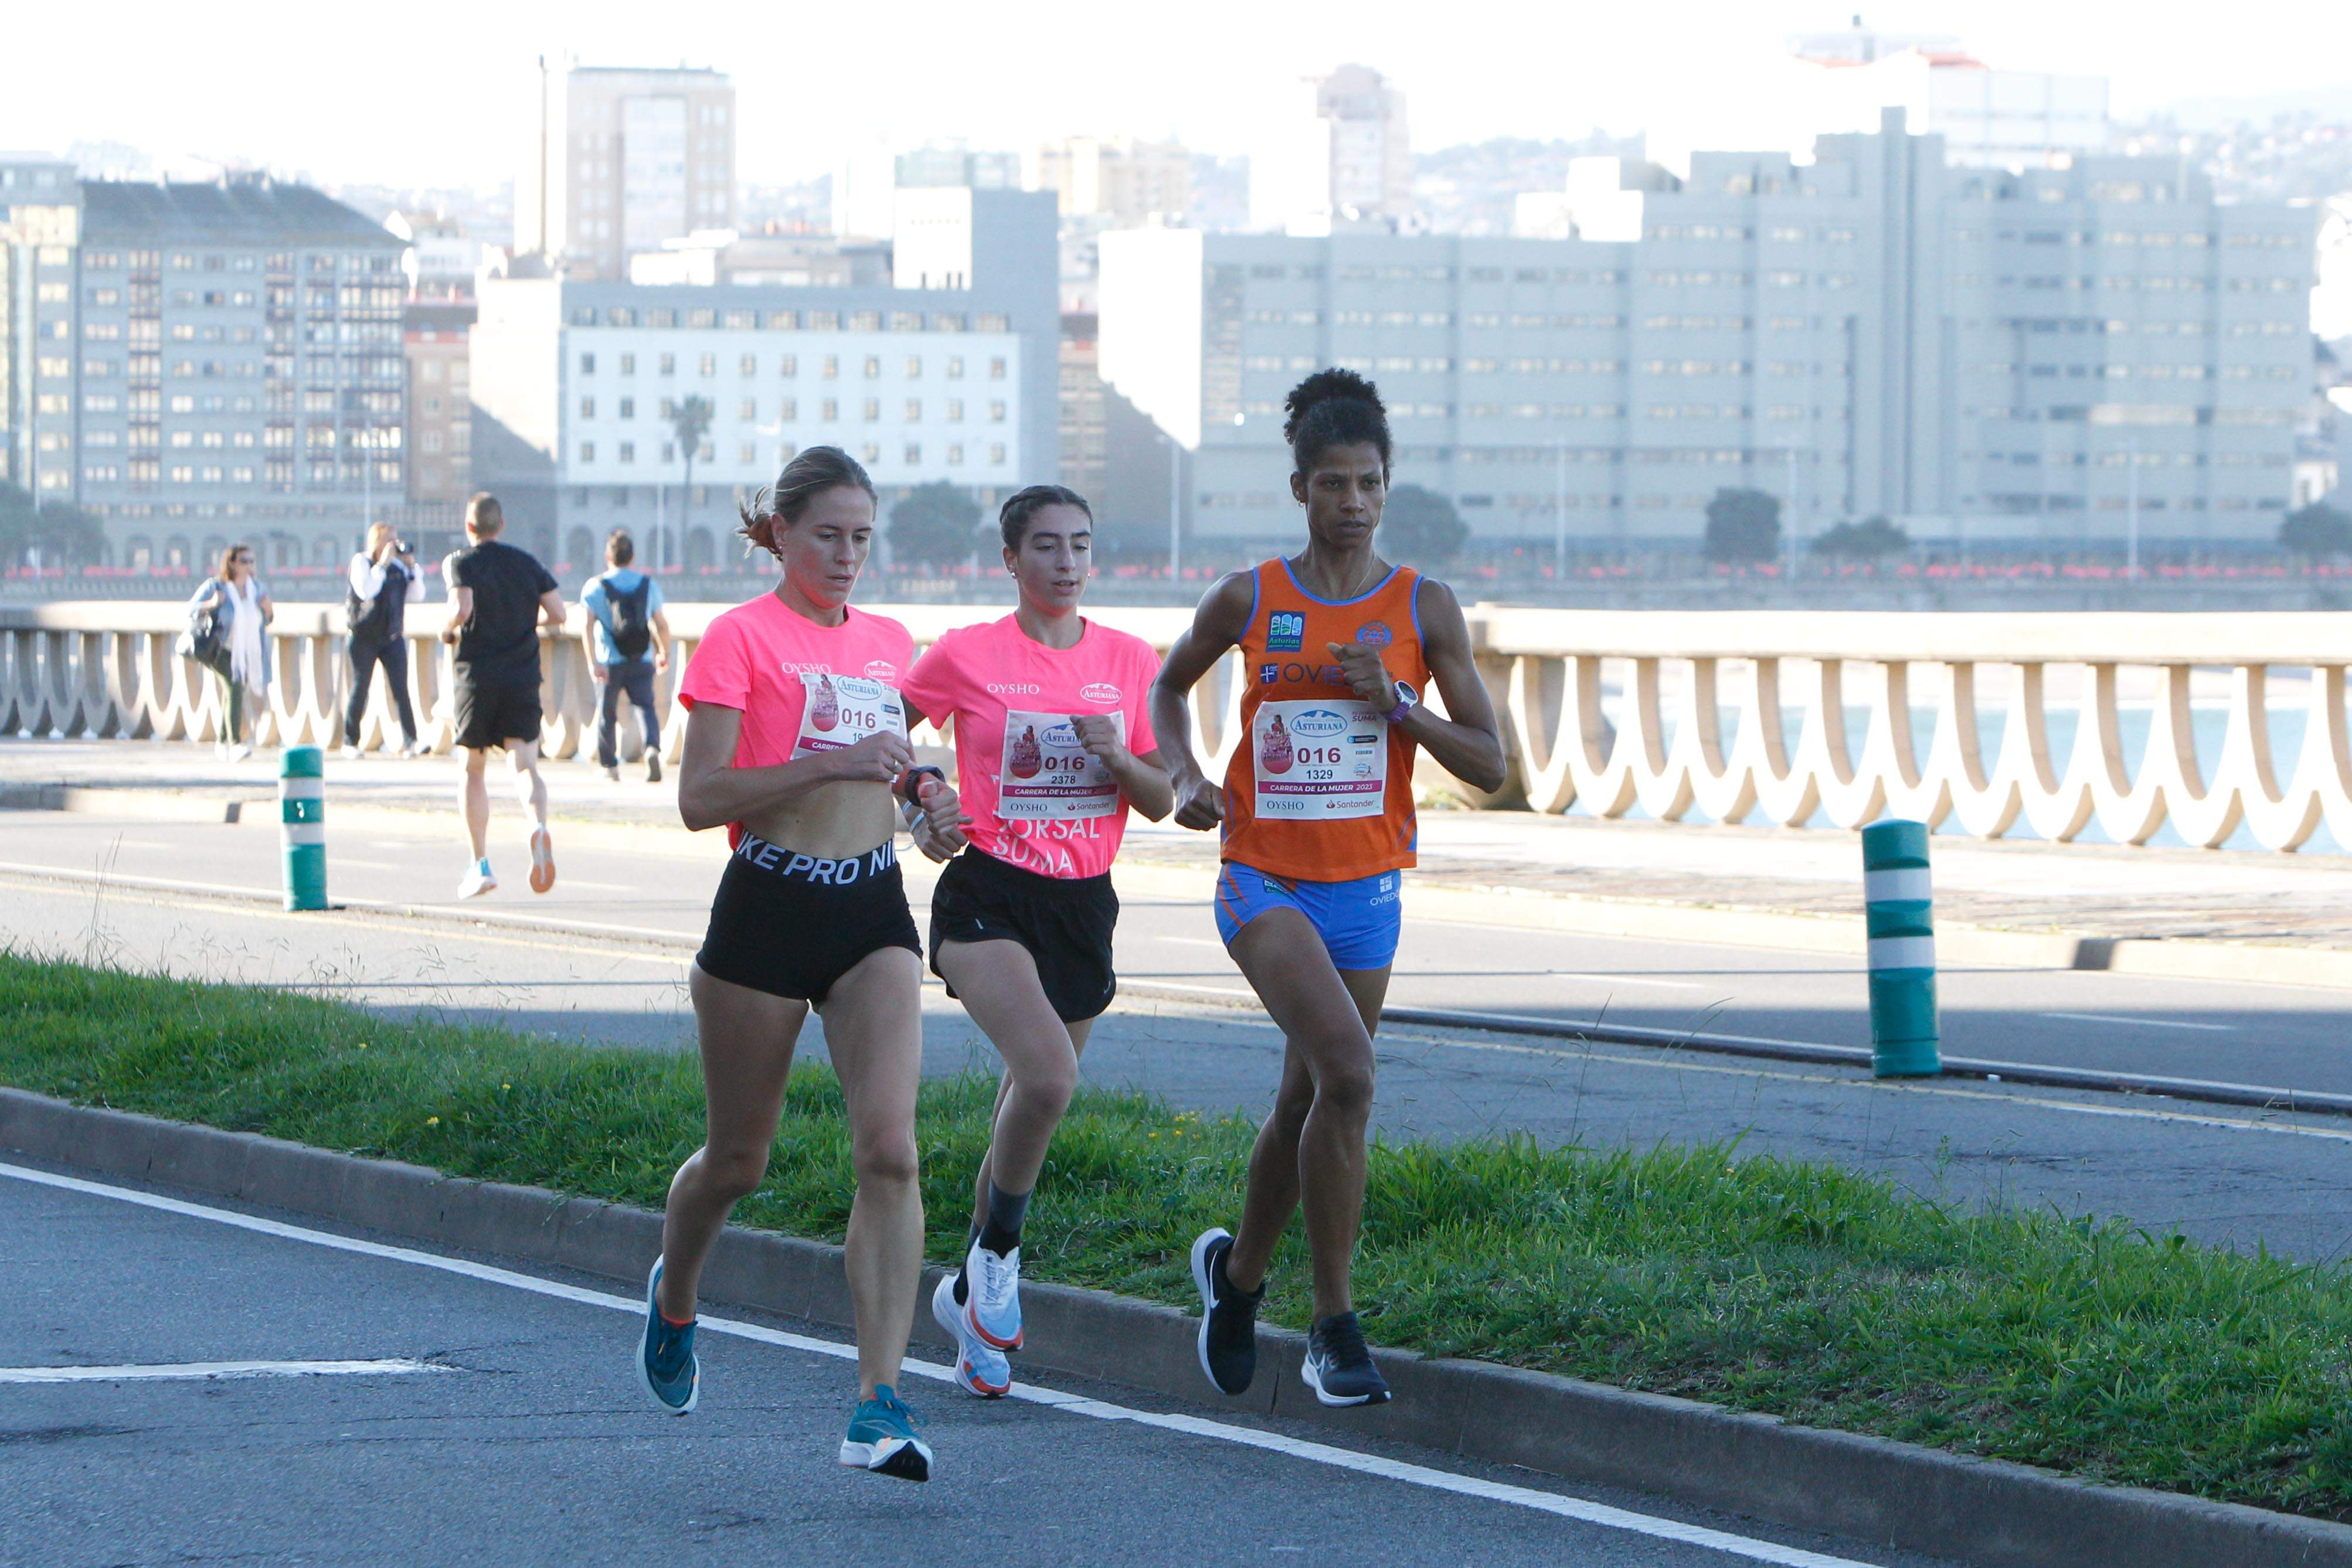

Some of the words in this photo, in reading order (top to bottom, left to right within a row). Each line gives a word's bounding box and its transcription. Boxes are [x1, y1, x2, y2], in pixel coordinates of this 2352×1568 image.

[781, 662, 831, 674] OYSHO
[1283, 663, 1343, 685] OVIE
[841, 679, 879, 696] ASTURIANA
[987, 683, 1040, 695] OYSHO
[1083, 689, 1120, 699] ASTURIANA
[842, 708, 876, 729] 016
[1294, 719, 1344, 731] ASTURIANA
[1045, 732, 1080, 743] ASTURIA
[1297, 747, 1341, 764] 016
[1045, 756, 1085, 770] 016
[1051, 775, 1076, 785] 2378
[1306, 769, 1333, 780] 1329
[1010, 803, 1048, 812] OYSHO
[1076, 801, 1110, 811] Santander
[1266, 800, 1304, 811] OYSHO
[1336, 800, 1375, 809] Santander
[736, 830, 786, 870] IKE
[782, 853, 860, 885] PRO
[993, 835, 1074, 874] SUMA
